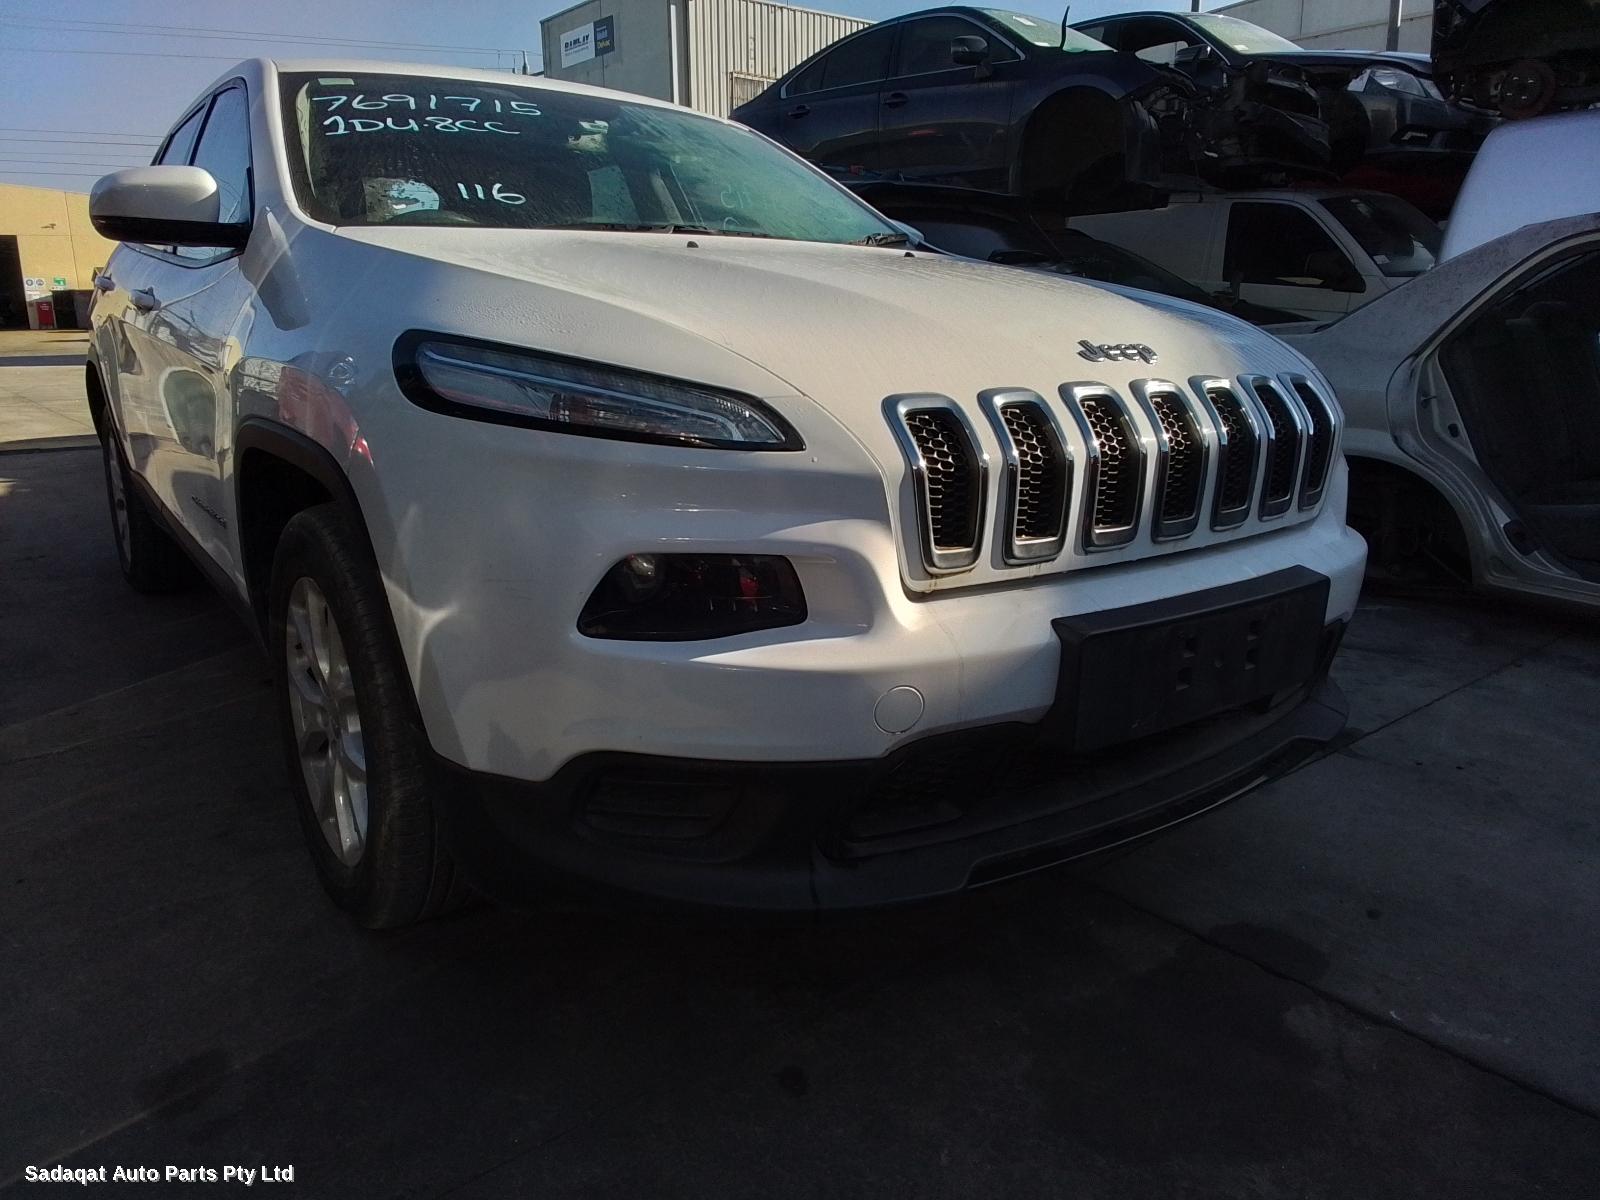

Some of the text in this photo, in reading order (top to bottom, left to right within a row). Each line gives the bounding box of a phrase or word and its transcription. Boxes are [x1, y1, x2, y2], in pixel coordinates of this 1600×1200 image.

[311, 94, 542, 116] 7691715
[456, 182, 527, 205] 116
[1077, 339, 1158, 365] Jeep
